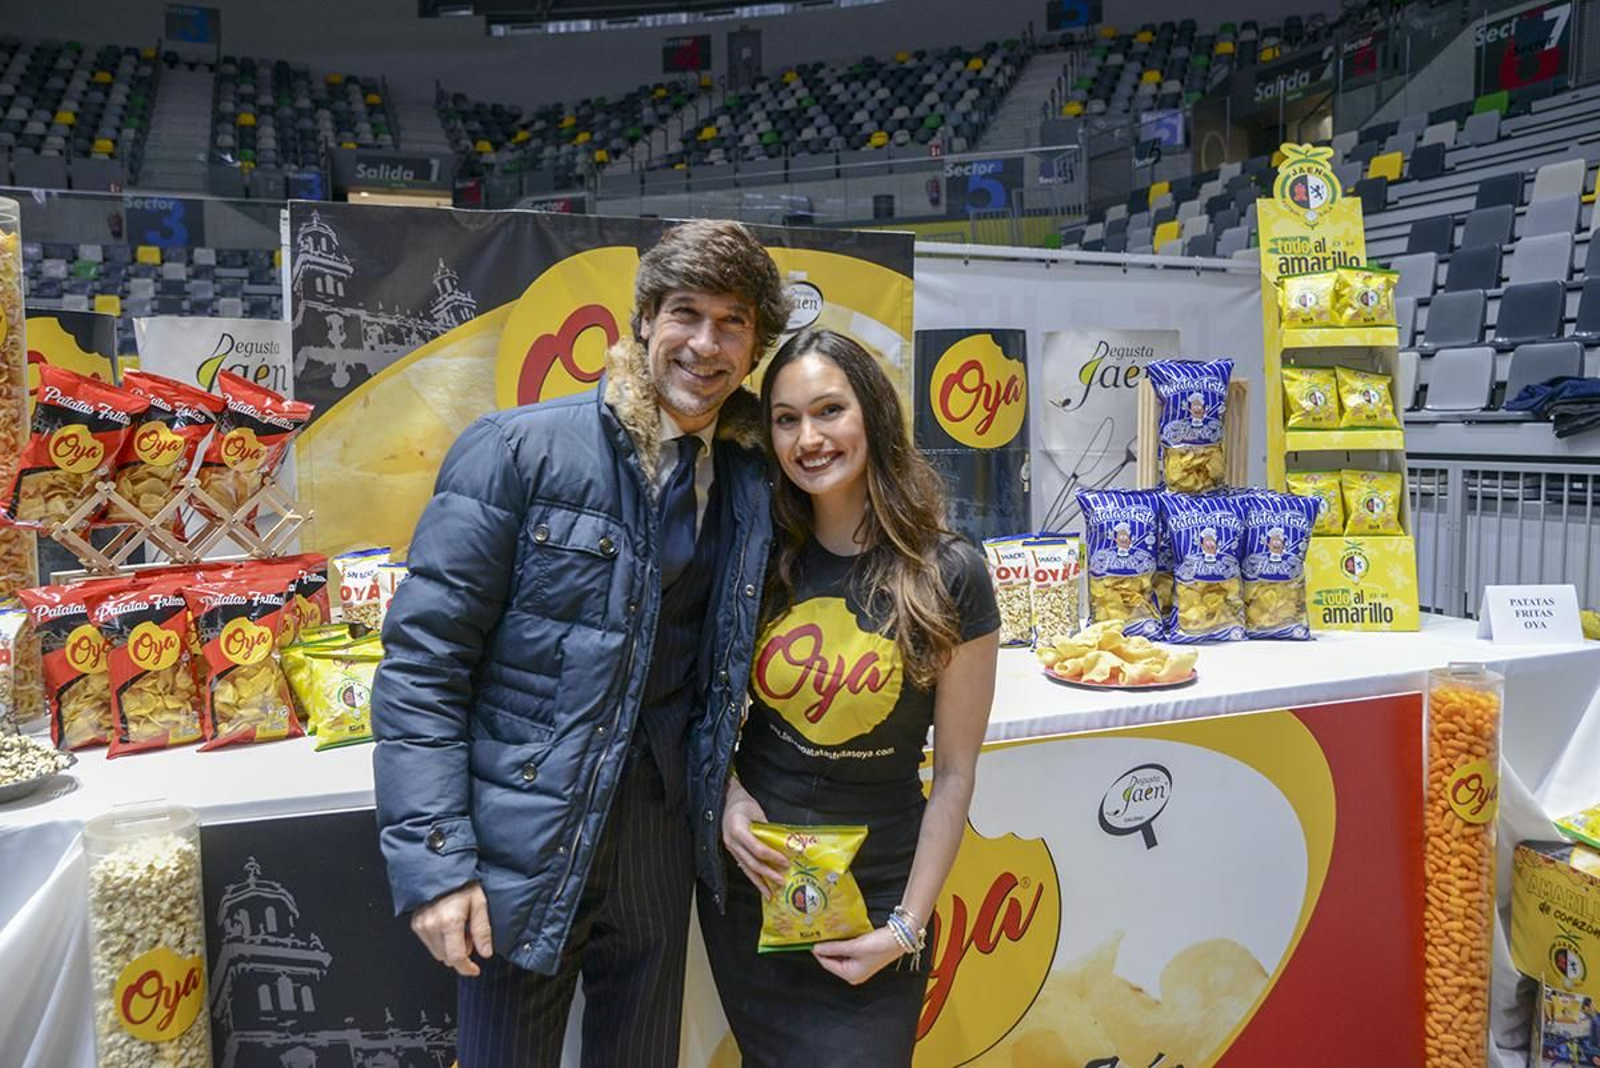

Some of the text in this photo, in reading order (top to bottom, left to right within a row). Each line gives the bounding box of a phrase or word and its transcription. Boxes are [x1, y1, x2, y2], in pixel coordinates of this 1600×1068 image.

[1543, 3, 1571, 50] 7
[1254, 69, 1311, 101] Salida
[355, 159, 441, 182] Salida 1
[944, 160, 995, 177] Sector
[144, 198, 189, 247] 3
[1313, 237, 1326, 254] al
[1278, 251, 1361, 276] amarillo
[1092, 341, 1154, 363] Degusta
[45, 385, 131, 425] Patatas Fritas
[222, 392, 262, 420] Patatas
[939, 359, 1025, 436] Oya
[53, 432, 101, 467] Oya
[136, 429, 183, 460] Oya
[223, 436, 262, 465] Oya
[1169, 511, 1213, 533] Patatas
[95, 600, 149, 621] Patatas
[200, 594, 247, 610] Patatas
[1353, 590, 1364, 605] al
[1509, 597, 1555, 607] PATATAS
[1322, 603, 1394, 624] amarillo
[1515, 609, 1554, 618] FRITAS
[1524, 620, 1547, 630] OYA
[132, 631, 177, 665] Oya
[225, 627, 270, 661] Oya
[756, 623, 897, 724] Oya
[917, 871, 1045, 1042] ya
[121, 968, 202, 1032] Oya
